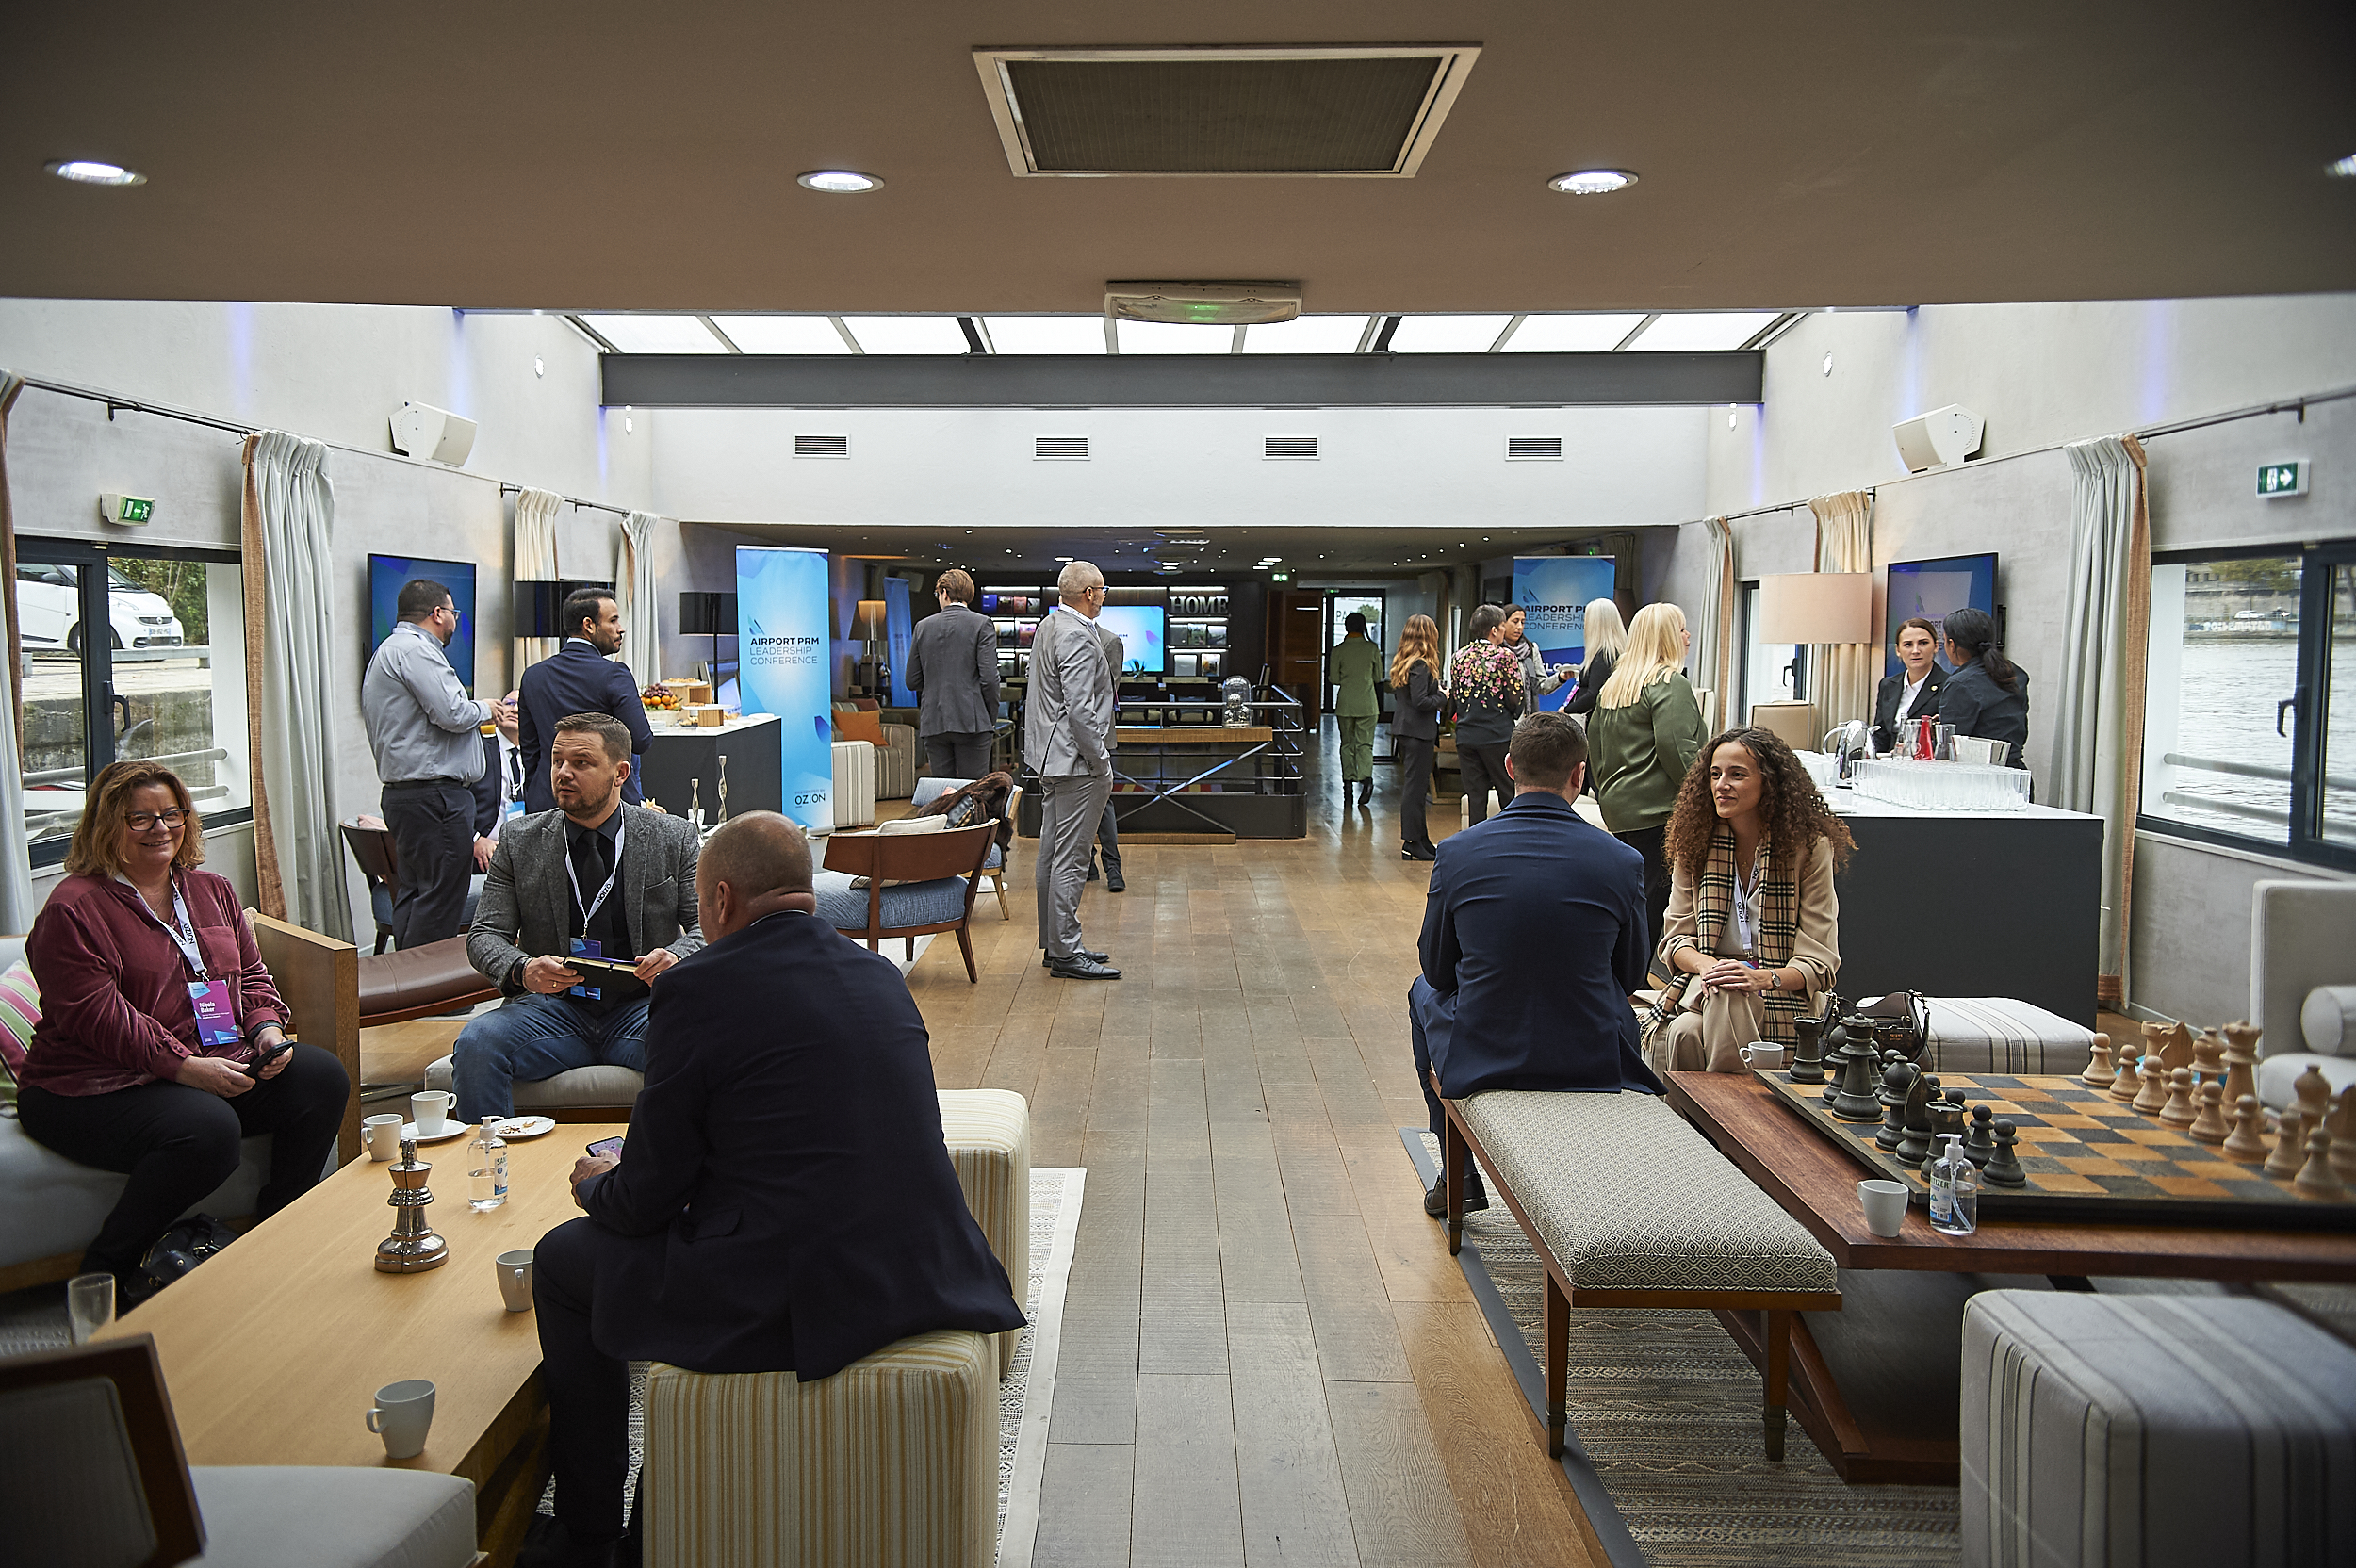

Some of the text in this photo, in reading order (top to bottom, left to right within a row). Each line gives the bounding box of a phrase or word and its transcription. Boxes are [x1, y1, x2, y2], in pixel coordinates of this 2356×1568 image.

[1169, 596, 1229, 614] HOME
[1524, 605, 1573, 613] AIRPORT
[750, 637, 820, 645] AIRPORT PRM
[749, 646, 812, 656] LEADERSHIP
[750, 656, 818, 665] CONFERENCE
[794, 792, 826, 805] OZION
[597, 883, 612, 904] OZION
[1737, 901, 1745, 923] OZION
[184, 923, 195, 944] OZION
